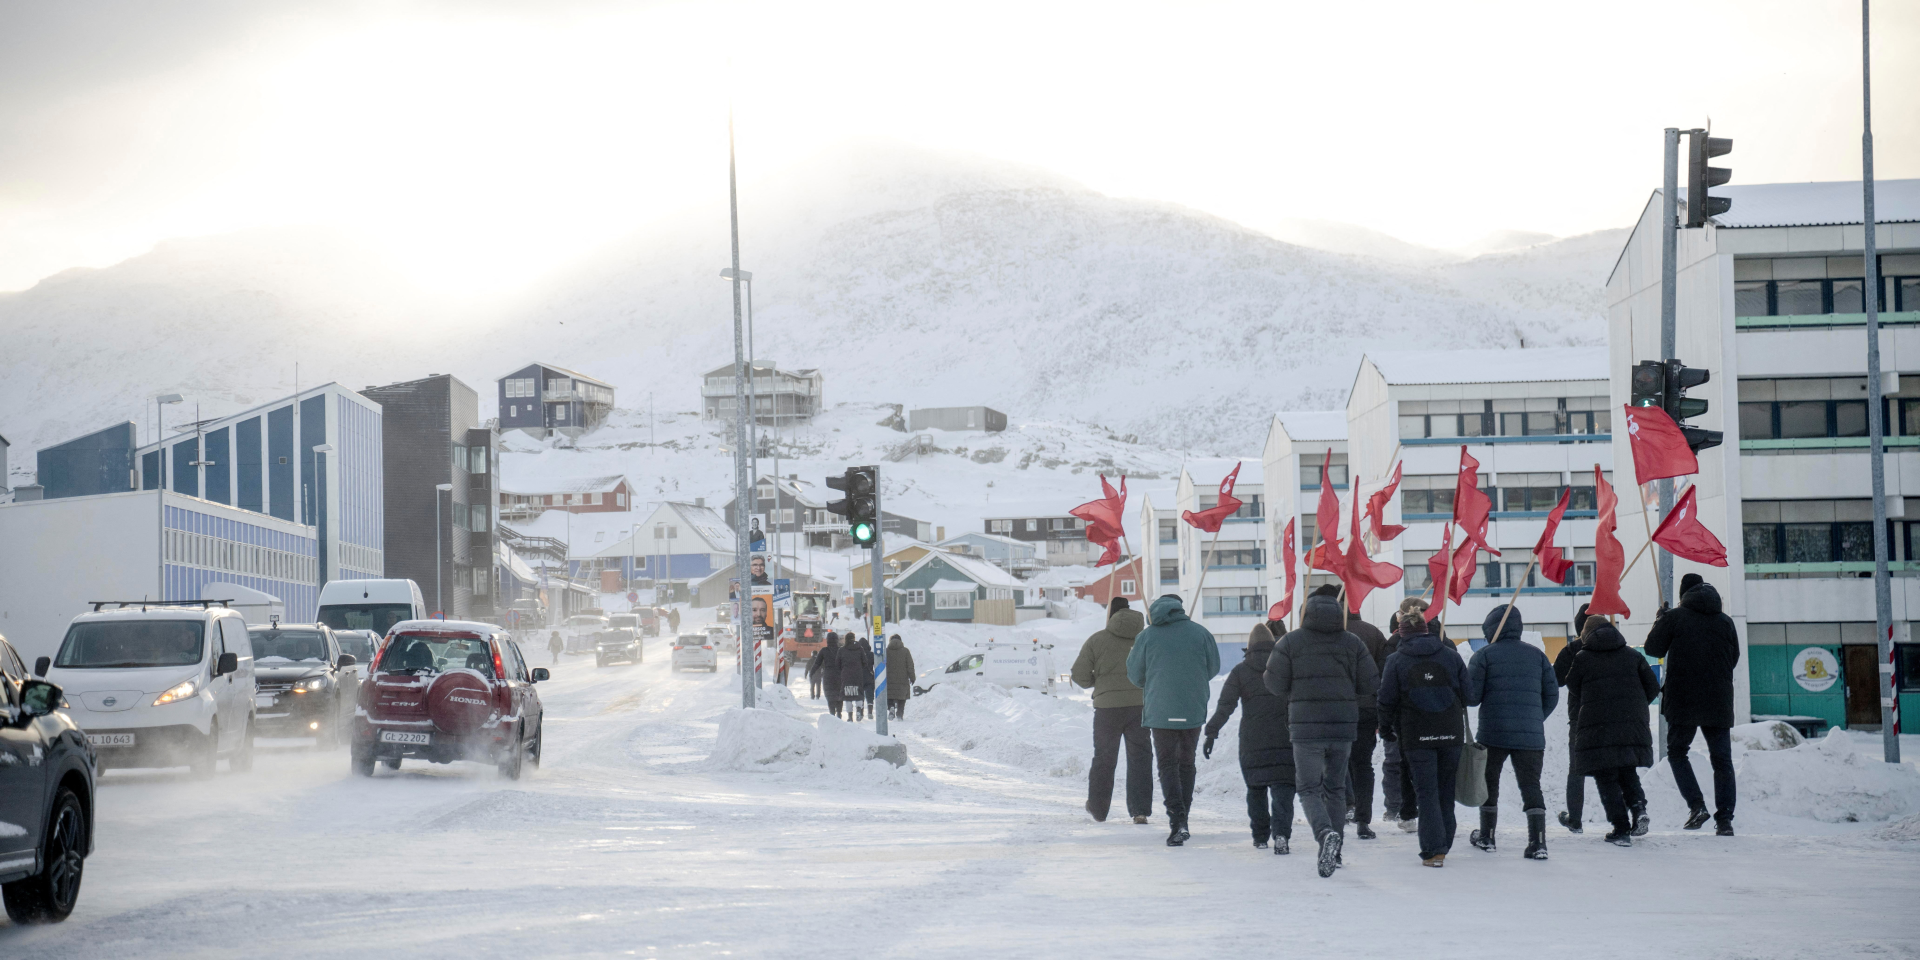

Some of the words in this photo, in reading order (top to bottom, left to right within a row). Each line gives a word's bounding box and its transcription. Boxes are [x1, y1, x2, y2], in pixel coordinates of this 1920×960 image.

[450, 696, 487, 706] HONDA
[101, 735, 112, 744] 10
[113, 735, 131, 744] 643
[385, 732, 396, 741] GL
[398, 733, 410, 742] 22
[410, 734, 426, 743] 202
